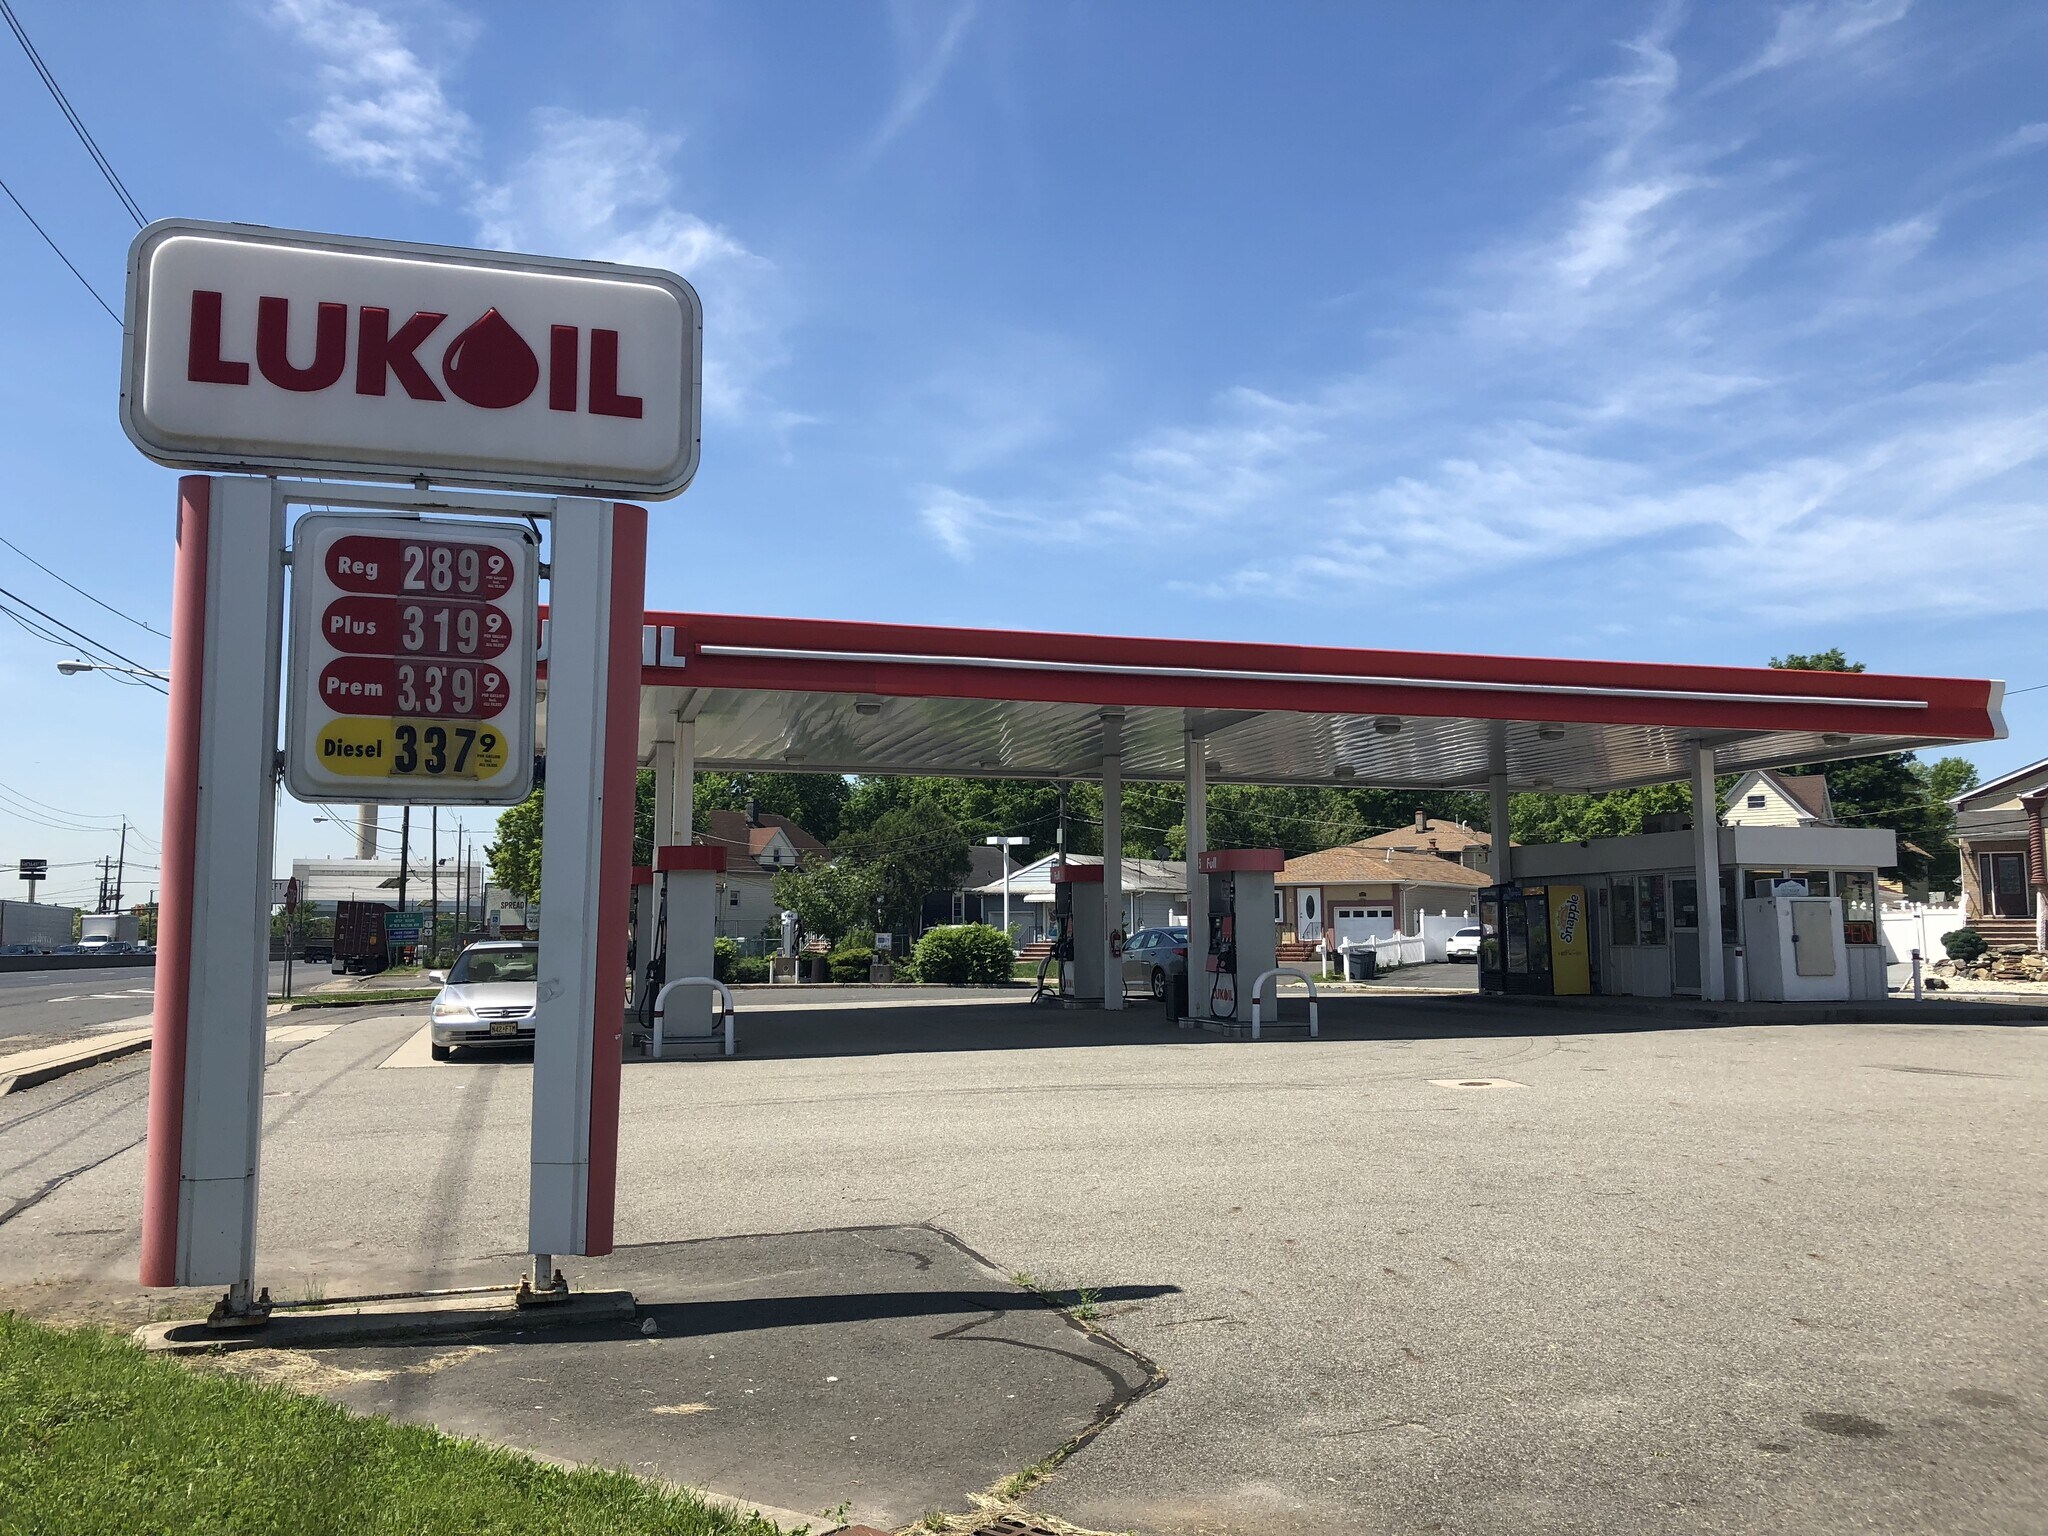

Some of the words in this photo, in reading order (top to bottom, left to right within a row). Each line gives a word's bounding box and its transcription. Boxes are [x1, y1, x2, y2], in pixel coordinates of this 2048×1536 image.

[188, 290, 643, 419] LUKOIL
[338, 556, 378, 581] Reg
[403, 546, 480, 593] 289
[330, 615, 377, 636] Plus
[402, 605, 479, 654] 319
[326, 676, 383, 697] Prem
[324, 739, 382, 758] Diesel
[395, 725, 476, 774] 337
[500, 901, 525, 910] SPREAD
[1560, 894, 1579, 944] Snapple
